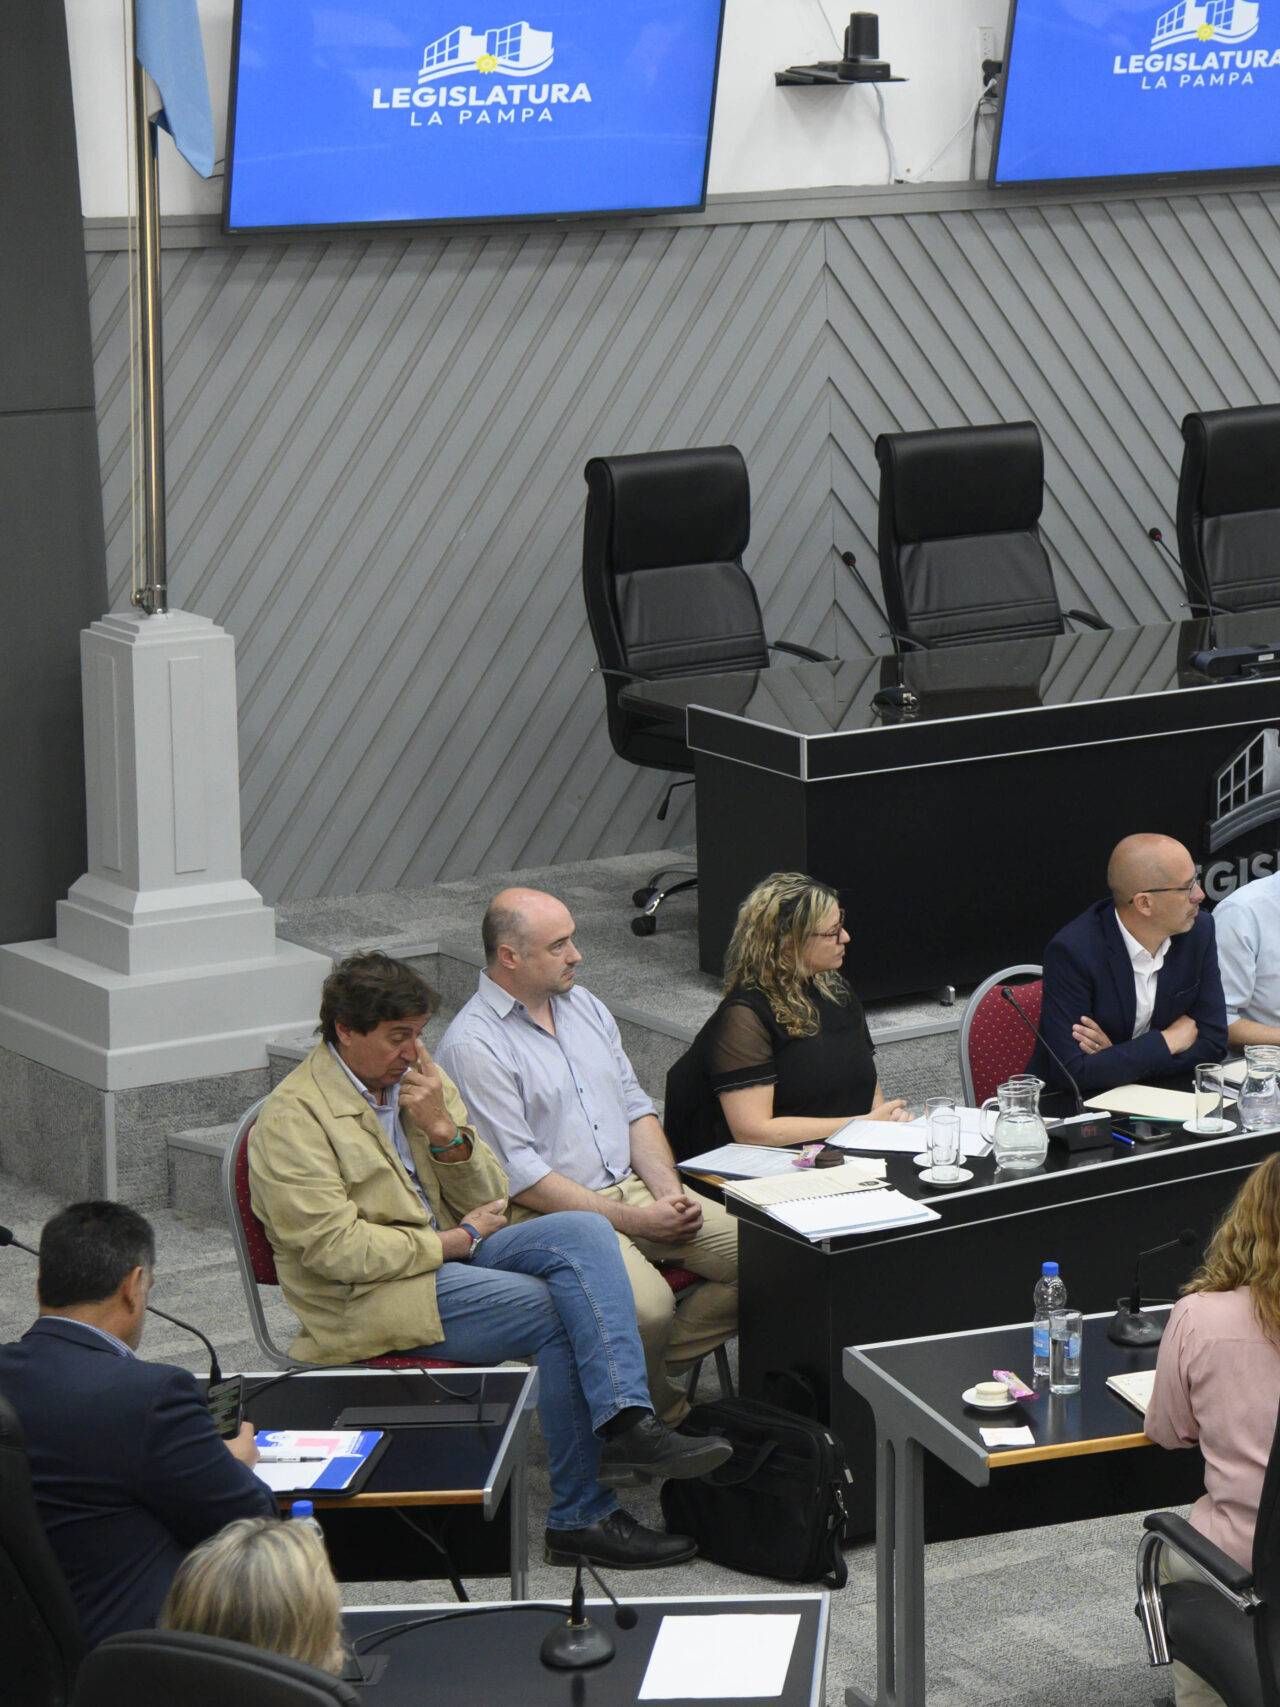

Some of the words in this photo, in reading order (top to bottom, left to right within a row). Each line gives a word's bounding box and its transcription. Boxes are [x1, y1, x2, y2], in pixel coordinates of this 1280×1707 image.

[1141, 76, 1168, 90] LA
[1179, 71, 1254, 88] PAMPA
[372, 83, 592, 109] LEGISLATURA
[410, 111, 443, 126] LA
[459, 107, 553, 125] PAMPA
